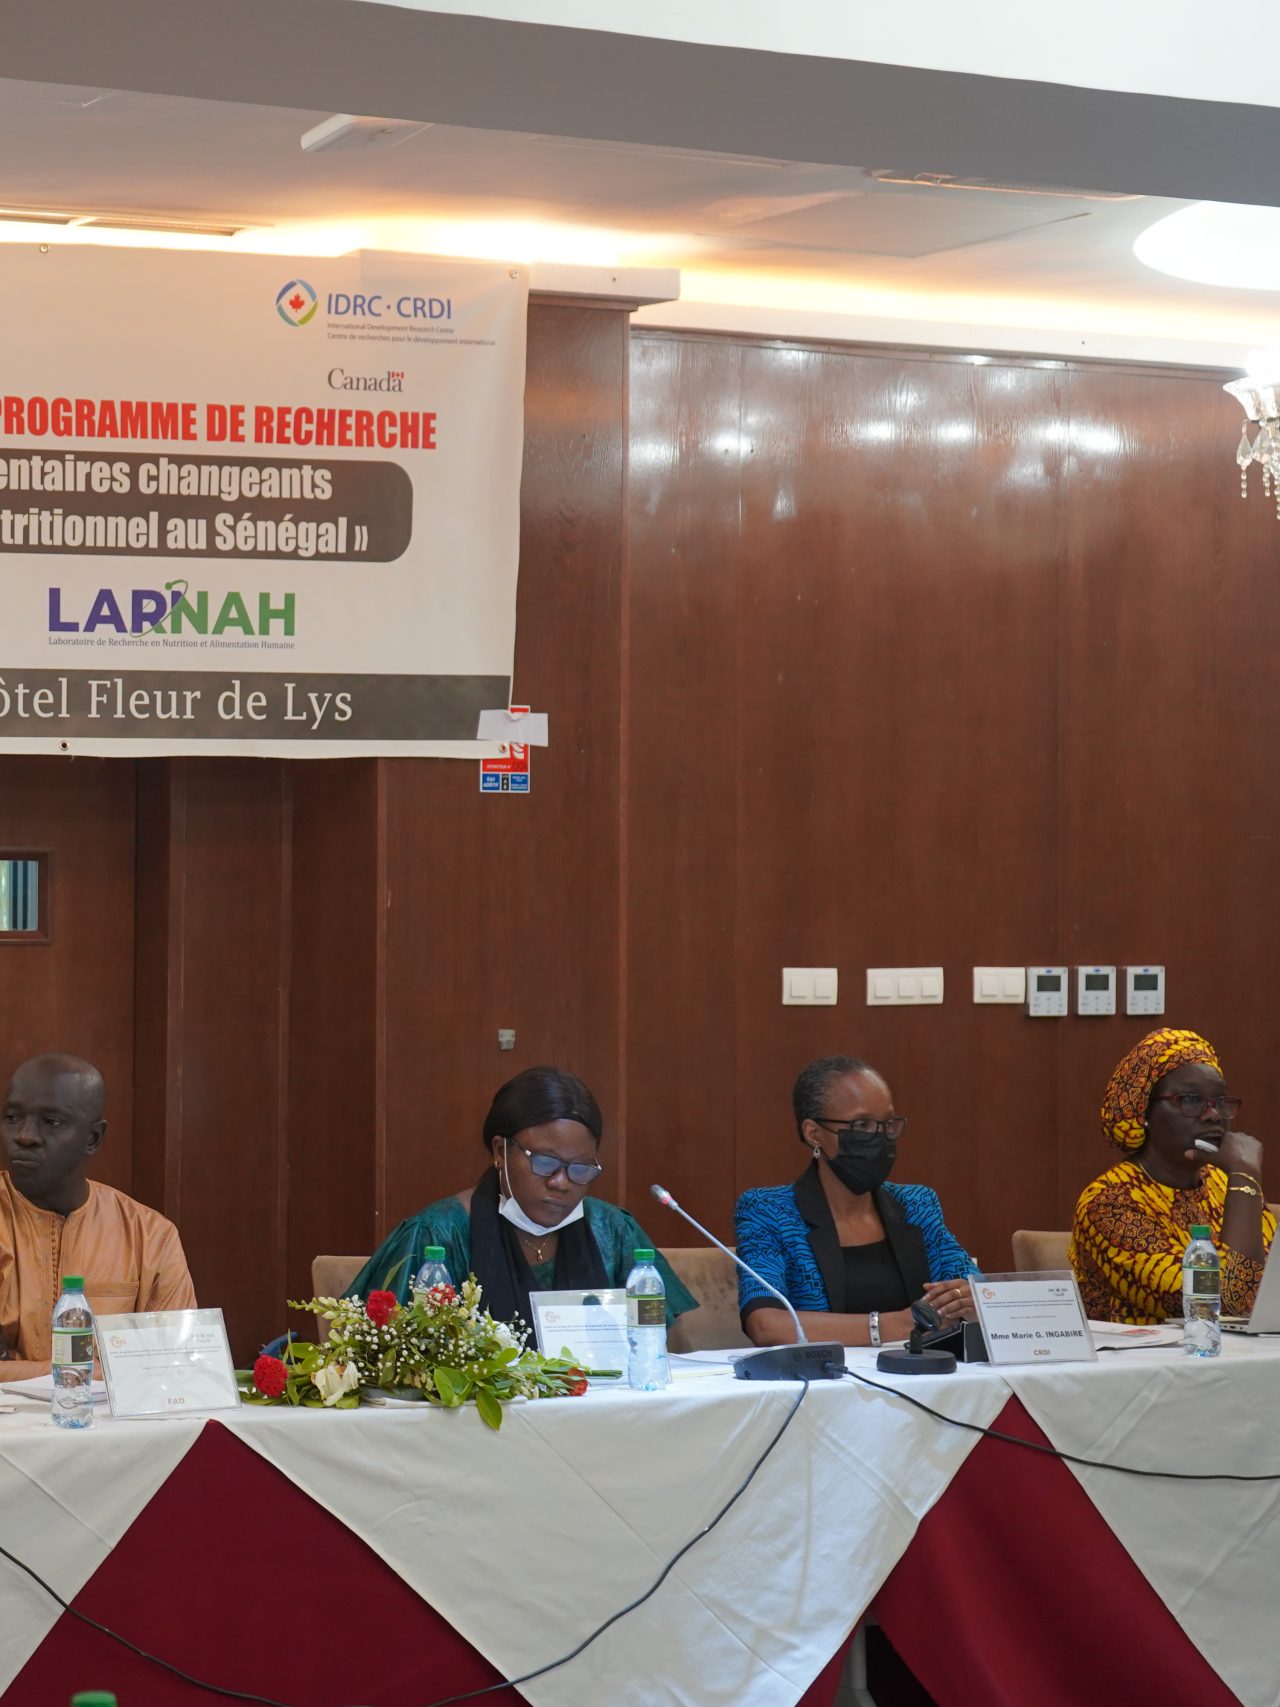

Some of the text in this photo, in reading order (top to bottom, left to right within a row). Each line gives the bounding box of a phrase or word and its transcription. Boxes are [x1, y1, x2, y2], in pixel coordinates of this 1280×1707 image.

[328, 294, 452, 320] IDRC CRDI
[328, 322, 366, 330] International
[368, 324, 408, 333] Development
[328, 368, 403, 393] Canada
[206, 404, 246, 443] DE
[254, 405, 437, 450] RECHERCHE
[138, 457, 333, 502] changeants
[166, 518, 207, 550] au
[215, 512, 348, 558] Sénégal
[48, 587, 296, 637] LARNAH
[48, 637, 95, 646] Laboratoire
[96, 638, 107, 646] de
[108, 638, 150, 647] Recherche
[162, 639, 199, 648] Nutrition
[200, 640, 208, 648] et
[210, 640, 260, 649] Alimentation
[261, 640, 296, 649] Humaine
[88, 678, 202, 721] Fleur
[218, 680, 268, 721] de
[284, 682, 353, 731] Lys
[1046, 1330, 1084, 1338] INGABIRE
[805, 1350, 833, 1359] BOSCH
